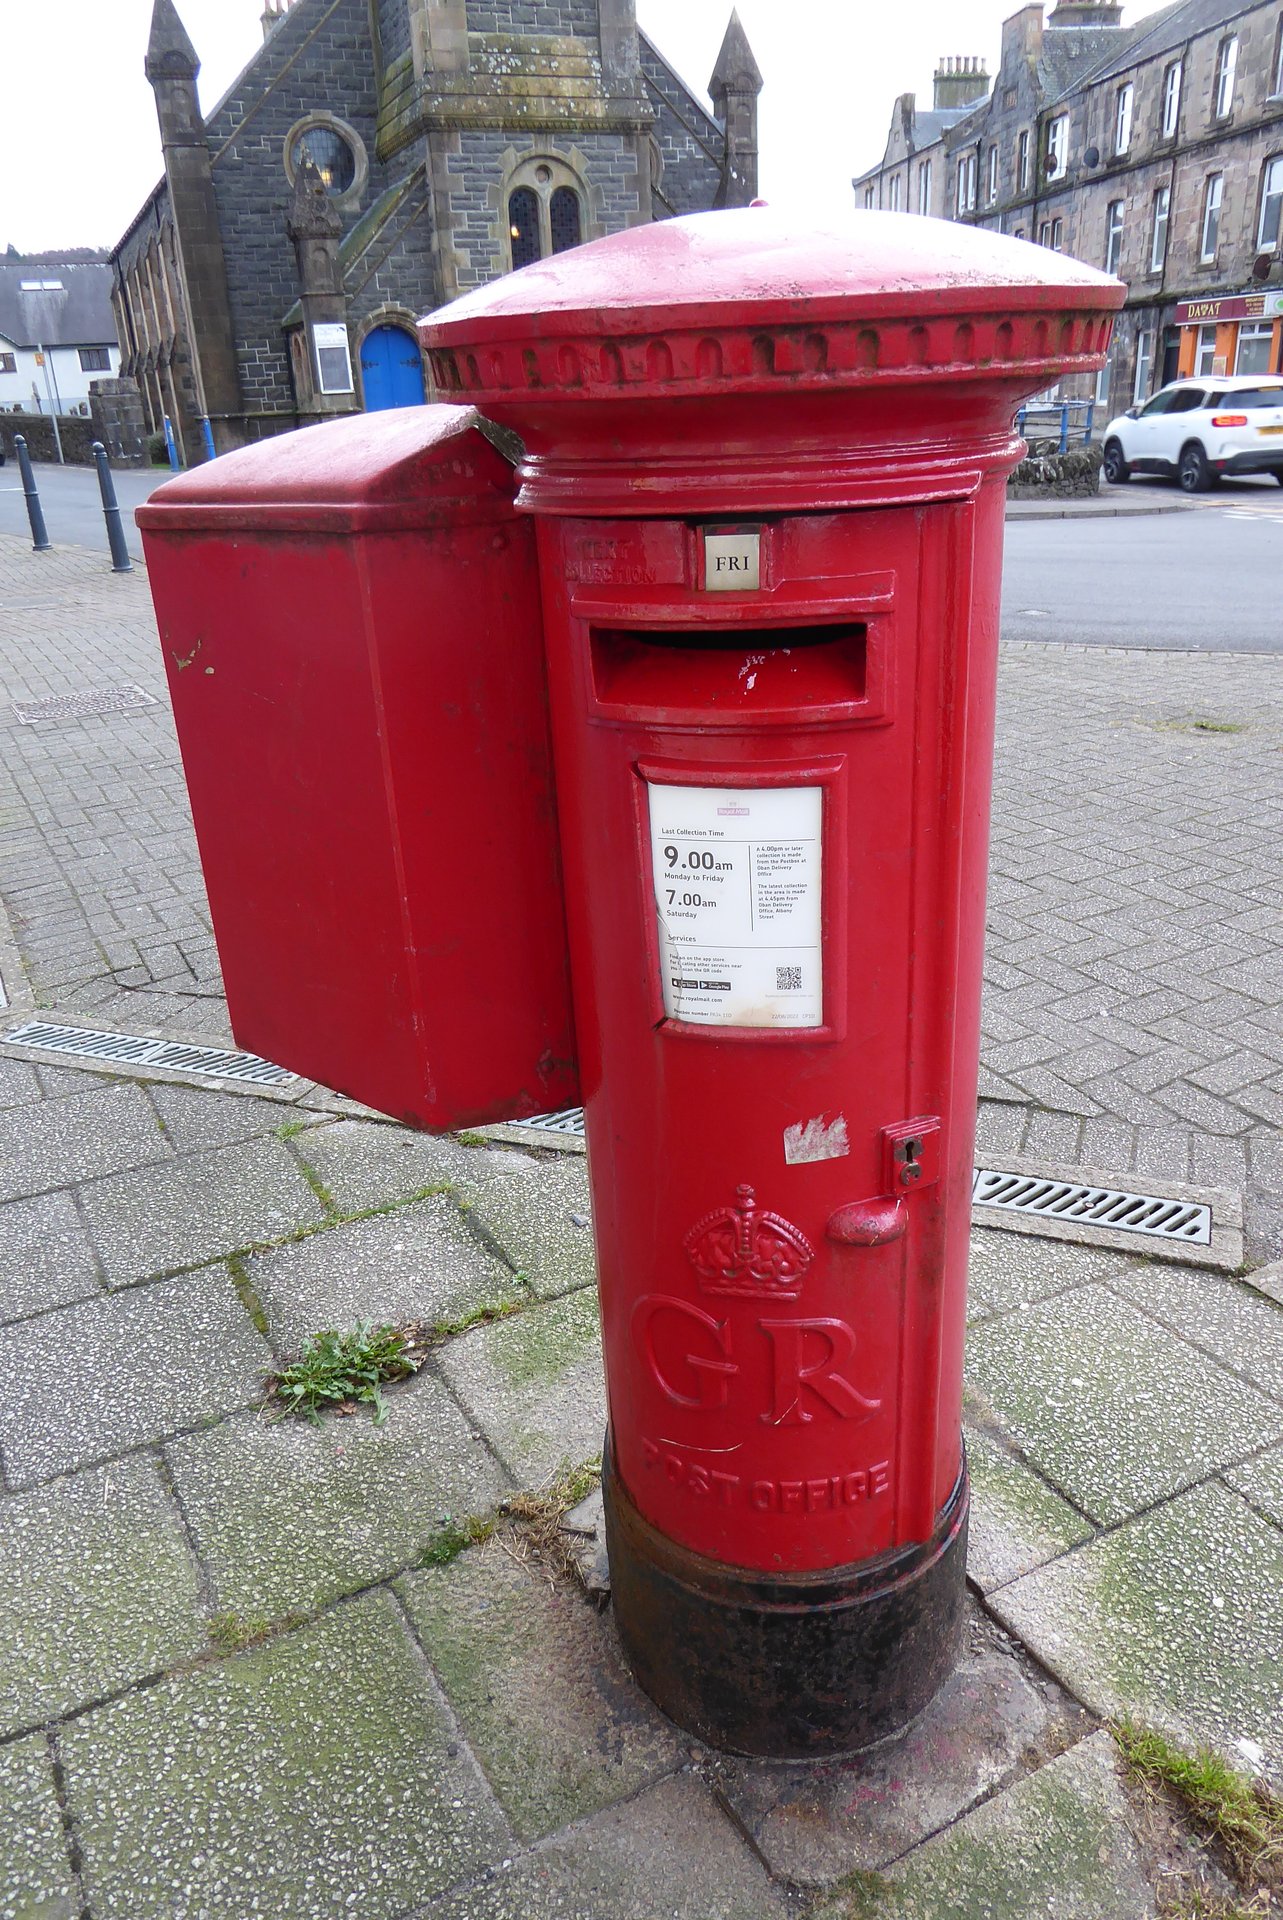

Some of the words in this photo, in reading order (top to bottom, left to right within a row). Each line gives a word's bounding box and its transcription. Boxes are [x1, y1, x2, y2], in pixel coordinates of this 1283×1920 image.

[1188, 302, 1221, 318] DAWAT
[715, 556, 749, 571] FRI
[664, 845, 733, 870] 9.00am
[665, 873, 691, 881] Monday
[702, 875, 724, 883] Friday
[666, 889, 717, 907] 7.00am
[667, 910, 697, 919] Saturday
[668, 934, 696, 942] Services
[673, 994, 723, 1003] www.royalmail.com
[641, 1435, 740, 1506] POST
[752, 1460, 889, 1513] OFFICE
